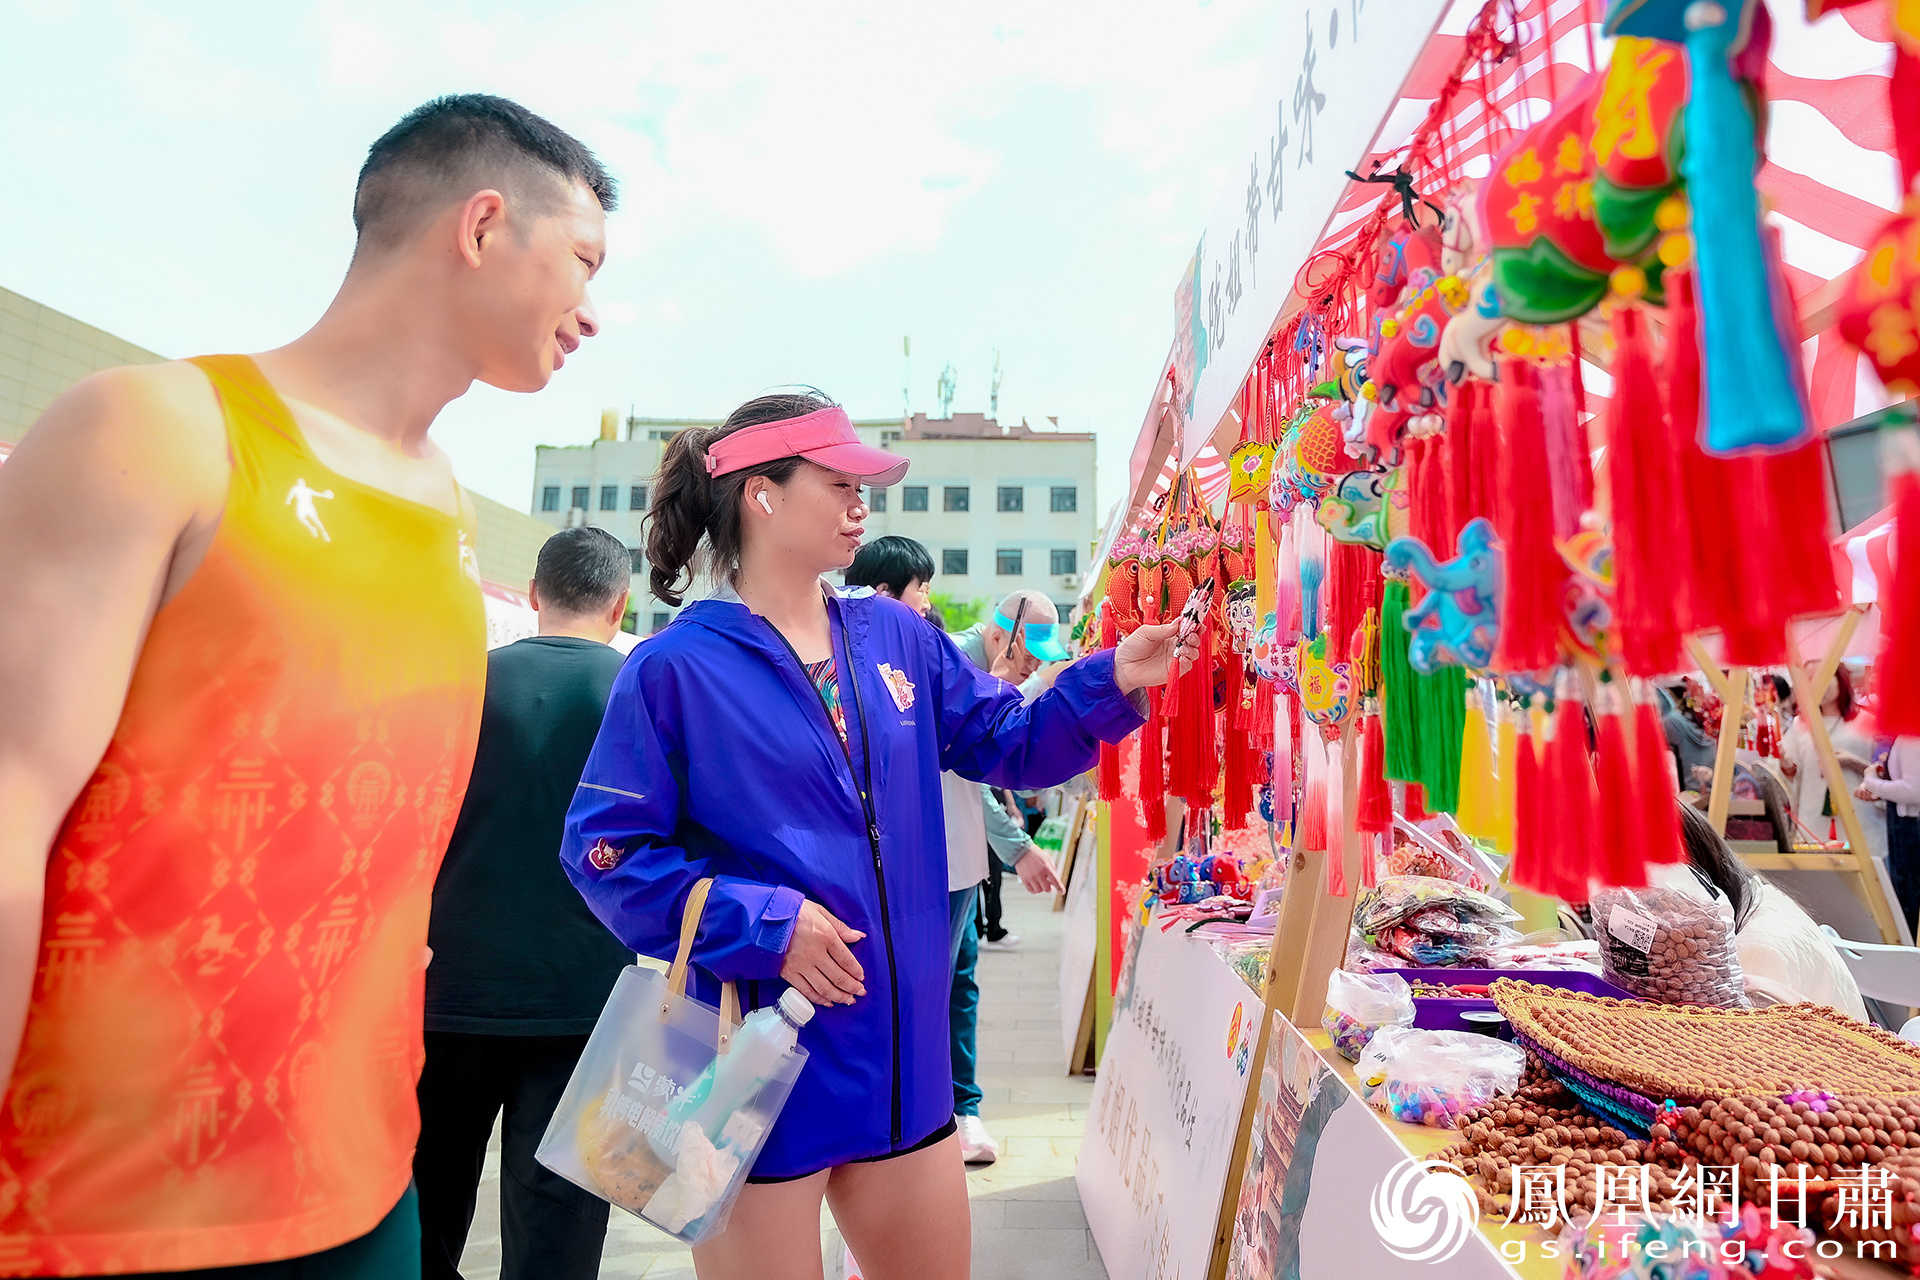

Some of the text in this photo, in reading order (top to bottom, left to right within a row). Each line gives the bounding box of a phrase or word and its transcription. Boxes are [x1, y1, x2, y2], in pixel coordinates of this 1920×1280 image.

[1207, 0, 1365, 364] 陇姐带甘味·
[1308, 674, 1322, 696] 福
